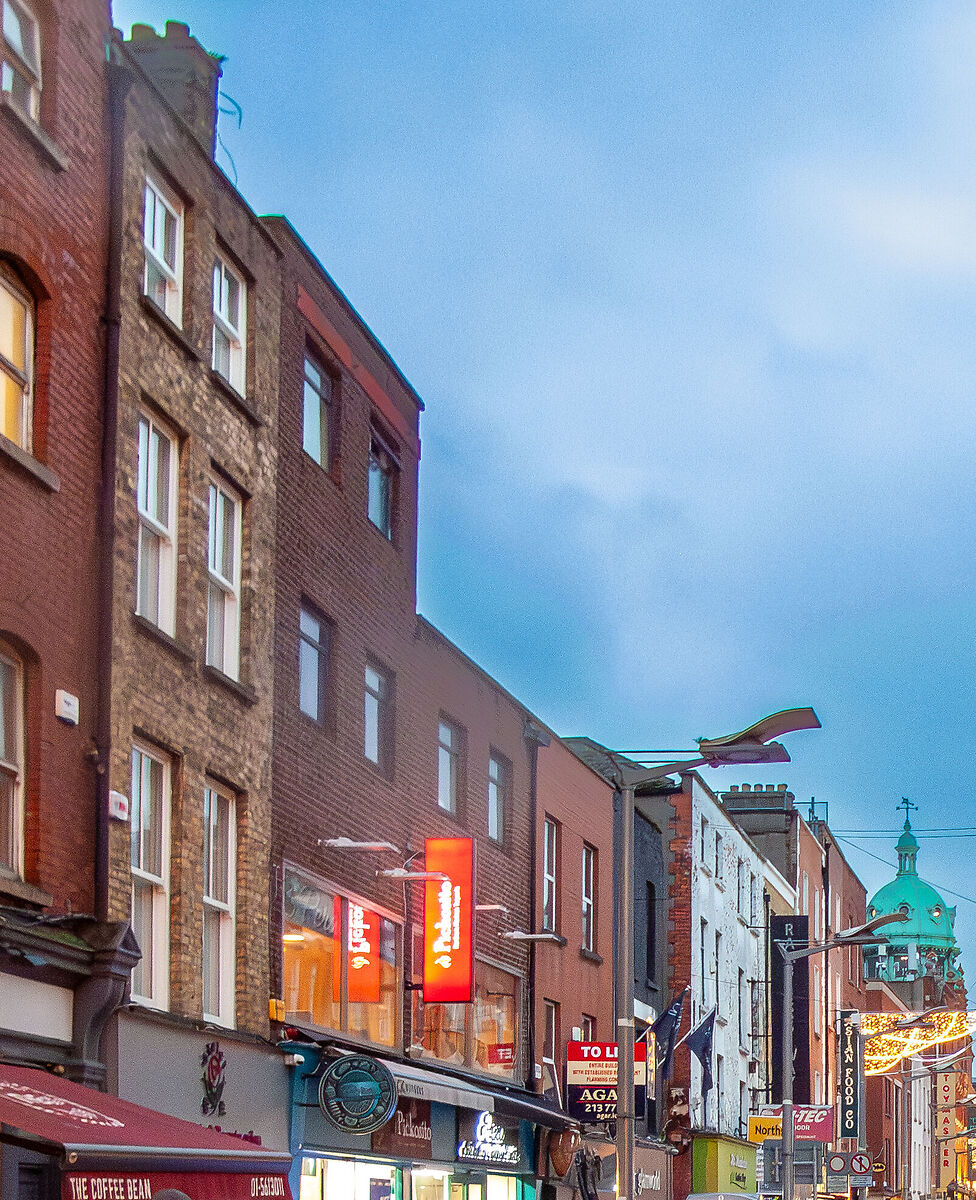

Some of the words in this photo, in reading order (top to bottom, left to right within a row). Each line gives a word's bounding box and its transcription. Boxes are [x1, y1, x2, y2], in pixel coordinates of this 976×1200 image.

[580, 1046, 602, 1058] TO
[845, 1068, 854, 1106] FOOD
[580, 1089, 618, 1101] AGA
[585, 1103, 603, 1112] 213
[70, 1177, 89, 1200] THE
[91, 1177, 125, 1200] COFFEE
[127, 1178, 152, 1200] BEAN
